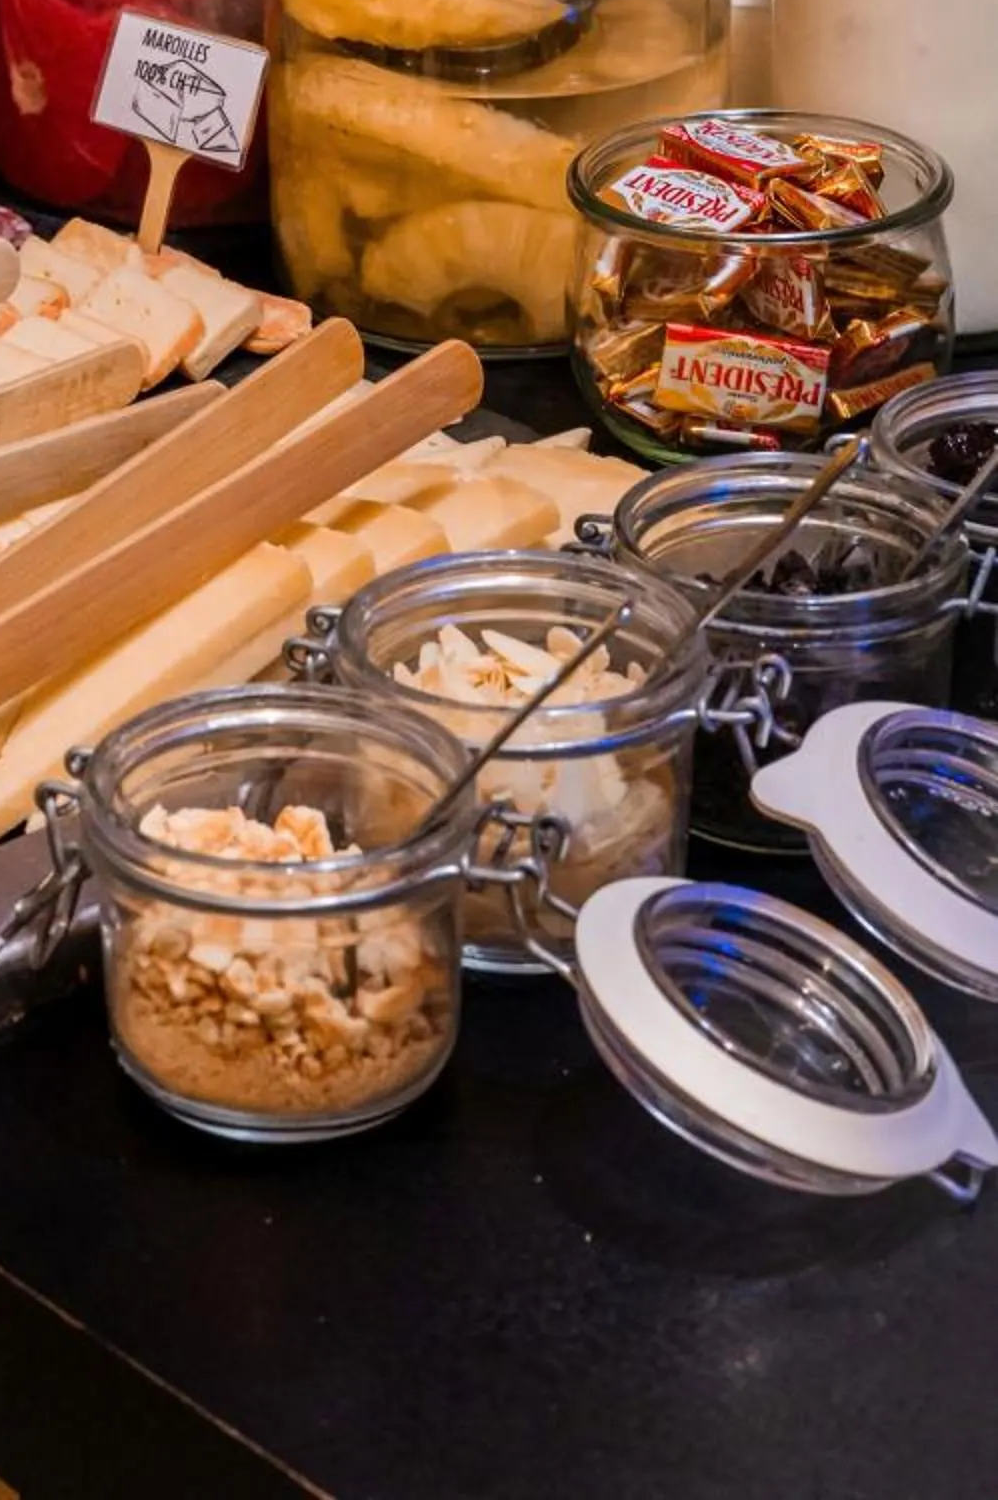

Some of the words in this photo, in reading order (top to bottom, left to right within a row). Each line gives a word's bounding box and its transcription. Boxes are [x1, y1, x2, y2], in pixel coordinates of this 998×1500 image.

[142, 28, 210, 64] MAROILLES
[134, 59, 169, 85] 100%
[624, 173, 740, 223] PRÉSIDENT
[672, 356, 822, 406] PRÉSIDENT
